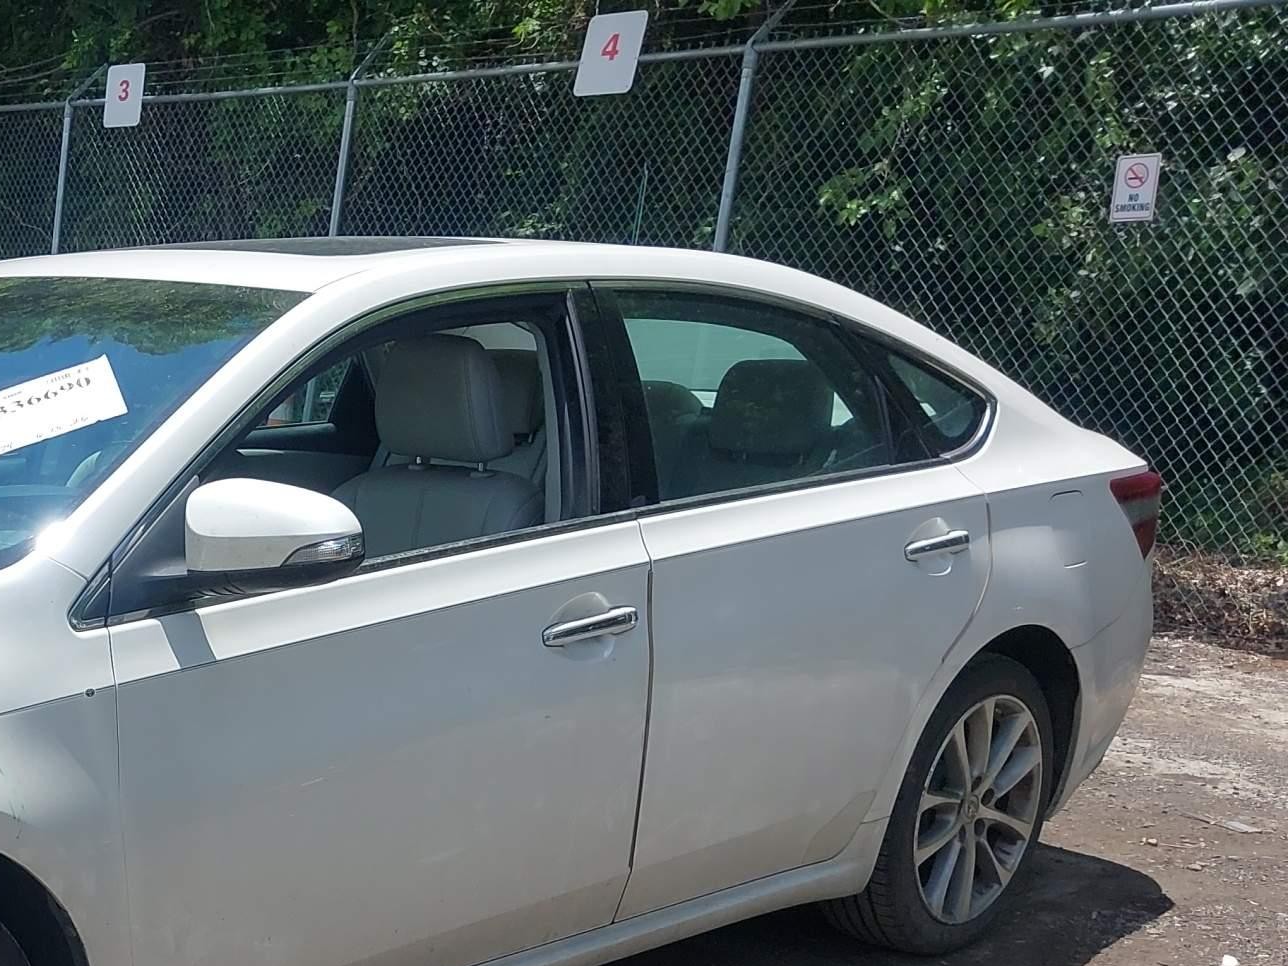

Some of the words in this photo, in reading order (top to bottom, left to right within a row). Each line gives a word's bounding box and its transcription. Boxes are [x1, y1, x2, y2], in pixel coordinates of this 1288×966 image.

[600, 33, 620, 61] 4
[118, 79, 130, 102] 3
[1128, 193, 1140, 202] NO
[1115, 202, 1150, 213] SMOKING
